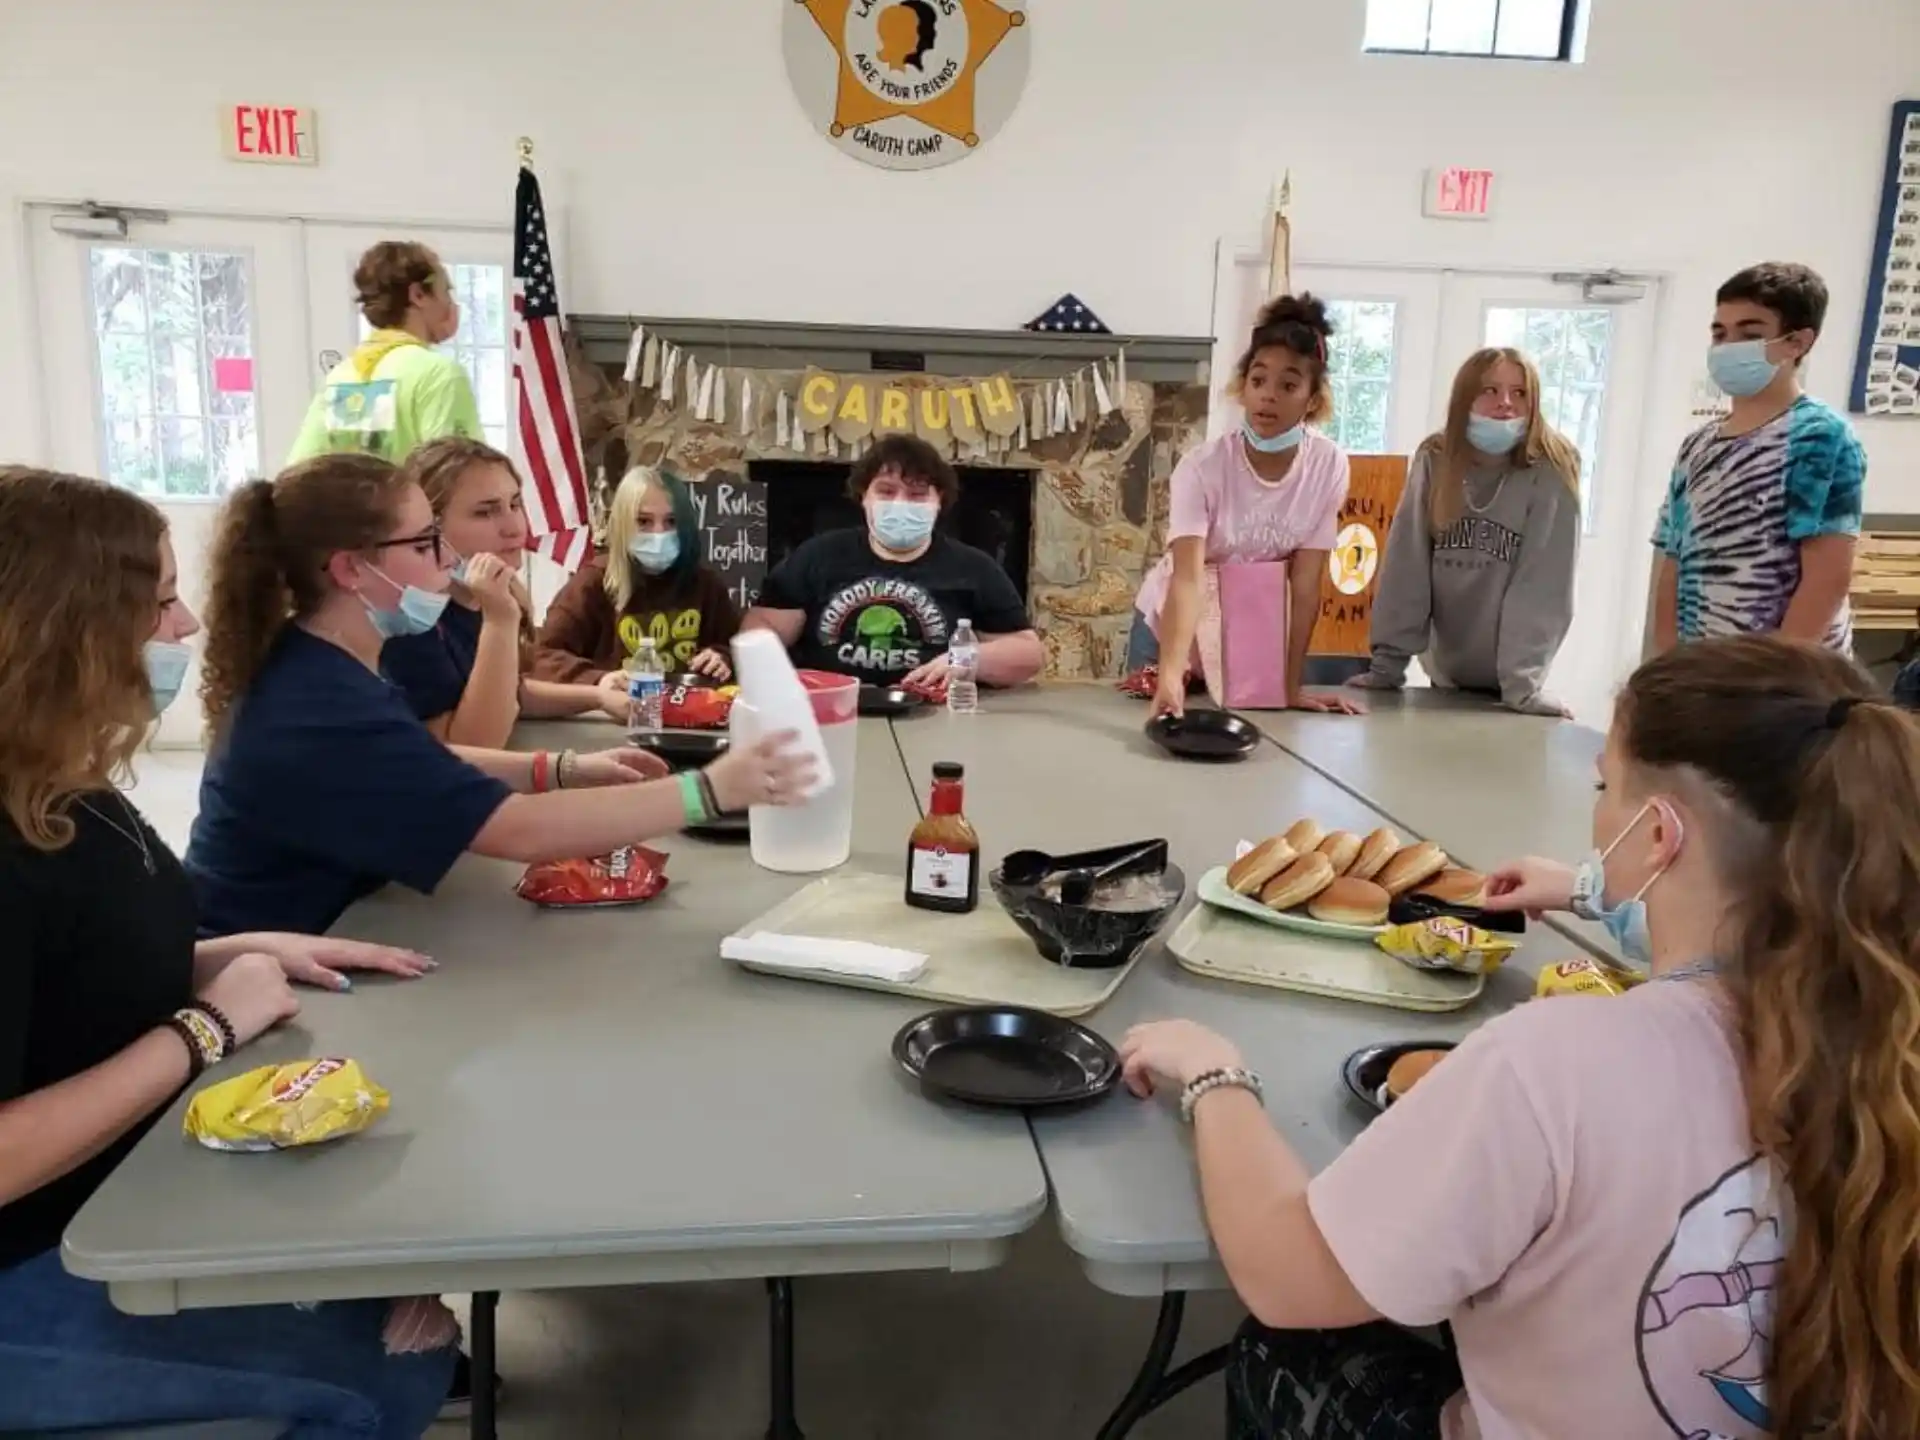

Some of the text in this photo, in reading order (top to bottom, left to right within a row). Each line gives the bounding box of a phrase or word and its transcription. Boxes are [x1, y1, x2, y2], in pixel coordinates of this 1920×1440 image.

[855, 54, 957, 99] ARE YOUR FRIENDS
[237, 106, 297, 156] EXIT
[853, 126, 942, 156] CARUTH CAMP
[1441, 170, 1493, 213] EXIT
[803, 376, 1014, 430] CARUTH
[718, 484, 767, 516] Rules
[706, 527, 767, 570] Together
[820, 580, 878, 636] NOBODY
[838, 643, 920, 671] CARES
